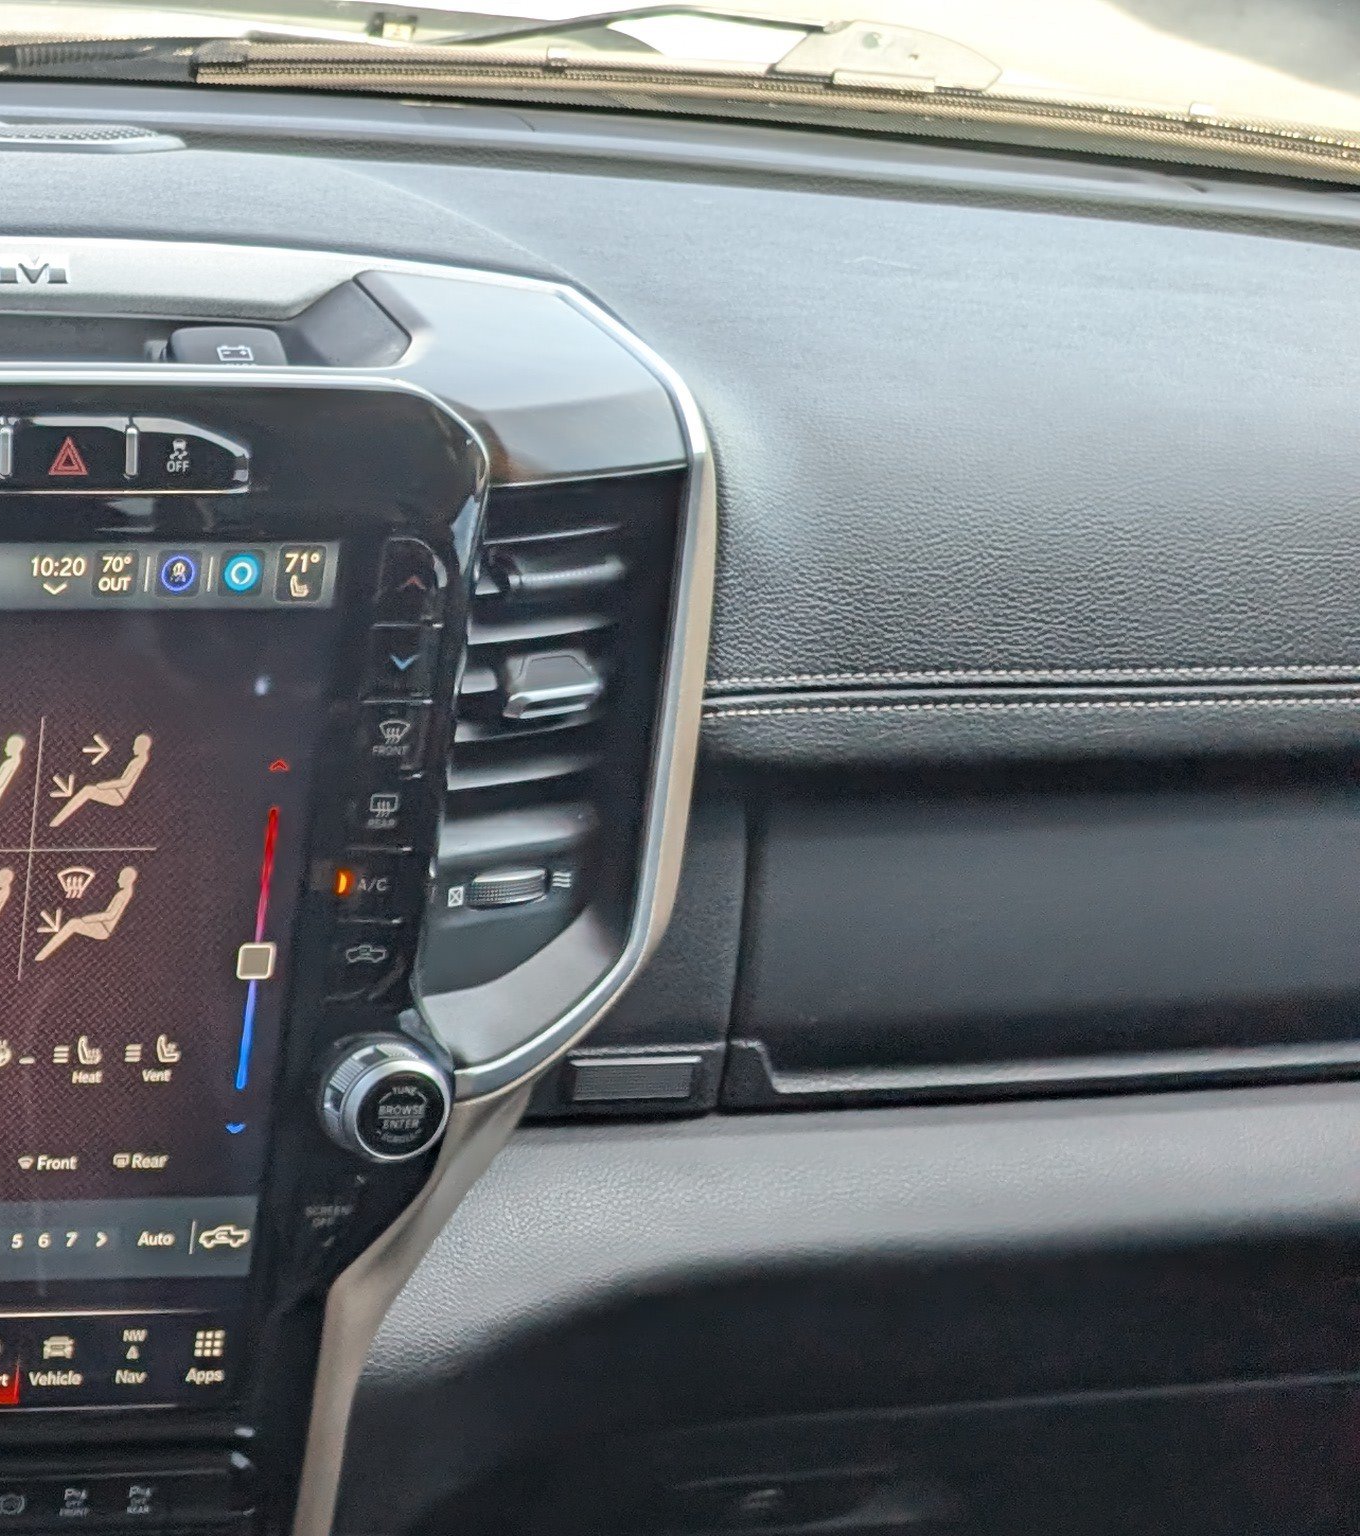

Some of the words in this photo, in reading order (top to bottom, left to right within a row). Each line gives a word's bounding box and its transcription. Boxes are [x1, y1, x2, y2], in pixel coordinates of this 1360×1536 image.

[166, 456, 191, 473] OFF
[31, 556, 86, 578] 10:20
[102, 555, 132, 573] 70°
[284, 553, 320, 573] 71°
[98, 576, 132, 592] OUT
[372, 744, 409, 757] FRONT
[357, 877, 388, 892] A/C
[71, 1070, 103, 1084] Heat
[142, 1069, 172, 1083] Vent
[378, 1104, 427, 1116] BROWSE
[382, 1119, 420, 1130] ENTER
[37, 1155, 77, 1170] Front
[131, 1154, 170, 1169] Rear
[11, 1234, 23, 1250] 5
[37, 1232, 51, 1249] 6
[65, 1231, 78, 1248] 7
[138, 1231, 176, 1247] Auto
[123, 1329, 147, 1344] NW
[29, 1370, 84, 1387] Vehicle
[115, 1369, 147, 1385] Nav
[186, 1367, 225, 1385] Apps
